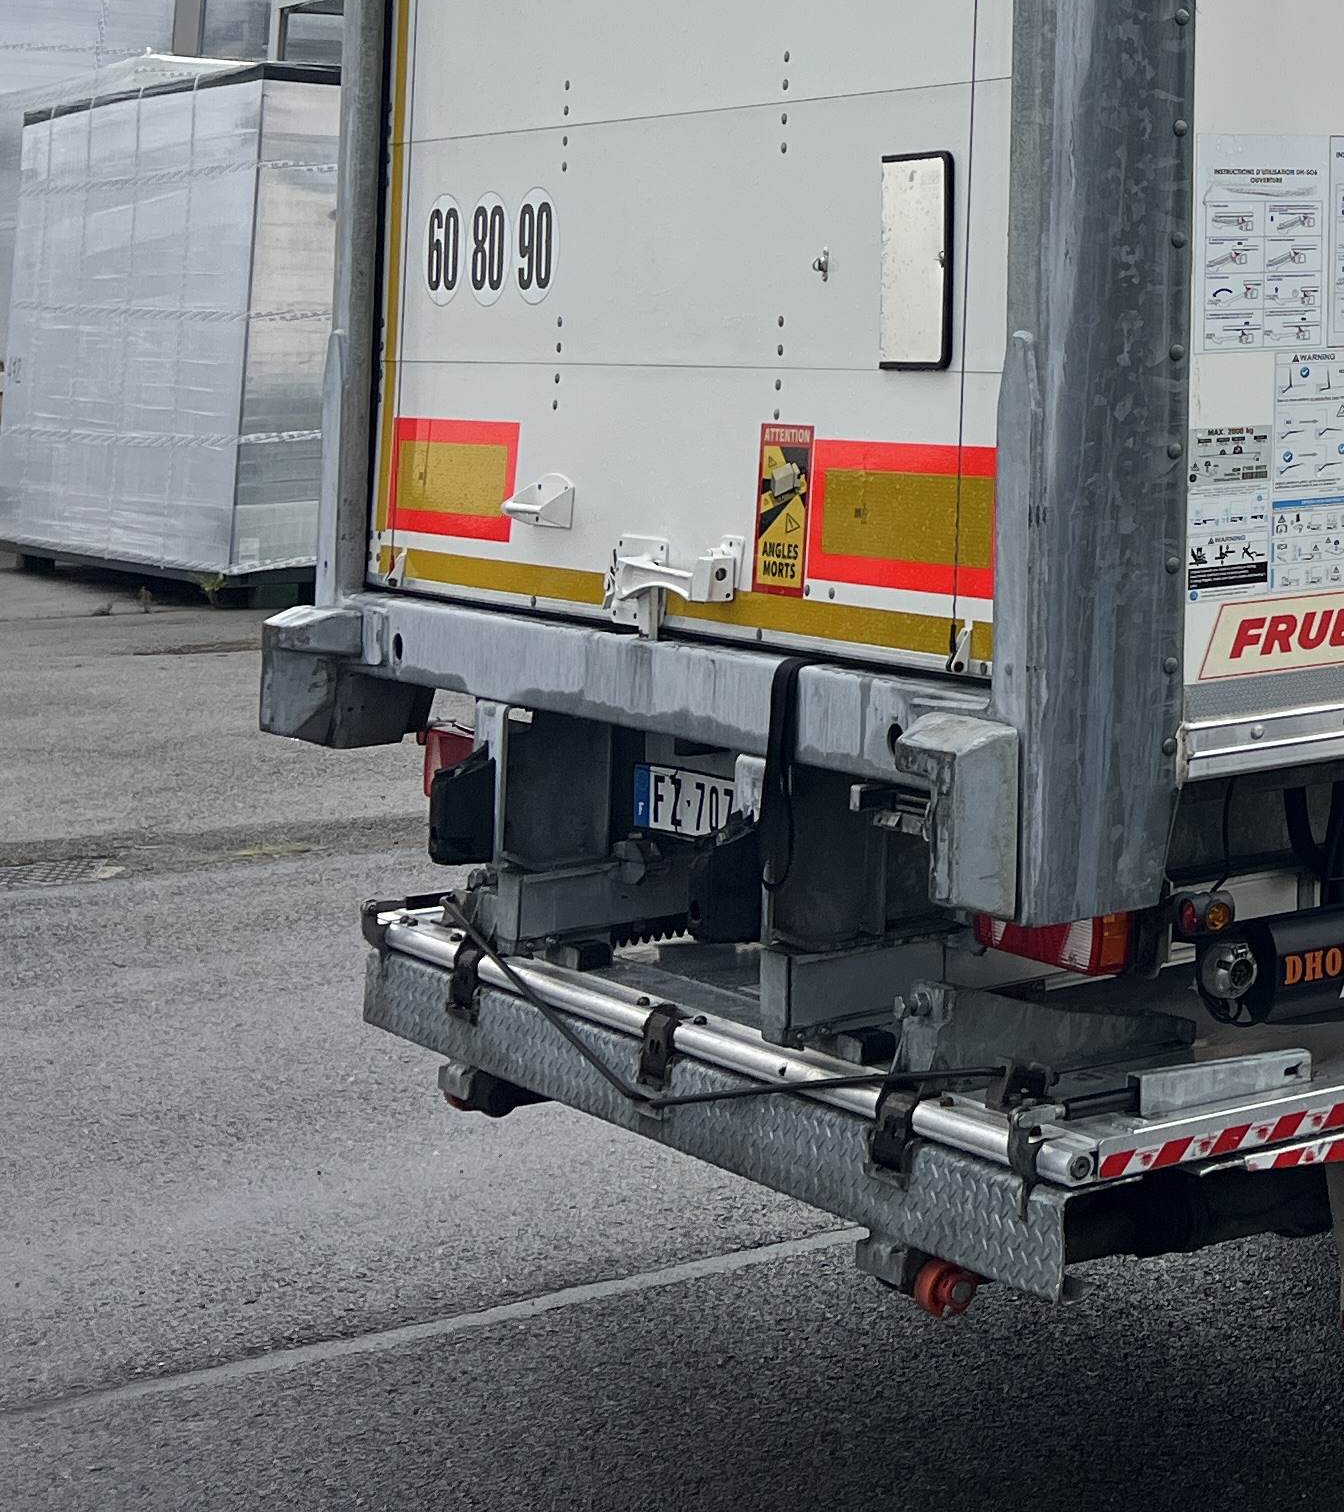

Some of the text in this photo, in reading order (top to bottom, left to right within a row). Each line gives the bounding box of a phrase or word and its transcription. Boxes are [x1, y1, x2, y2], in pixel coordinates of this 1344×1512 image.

[428, 207, 459, 291] 60
[472, 205, 504, 291] 80
[518, 202, 552, 290] 90
[1300, 353, 1335, 361] WARNING
[764, 427, 811, 444] ATTENTION
[762, 541, 799, 560] ANGLES
[762, 561, 796, 579] MORTS
